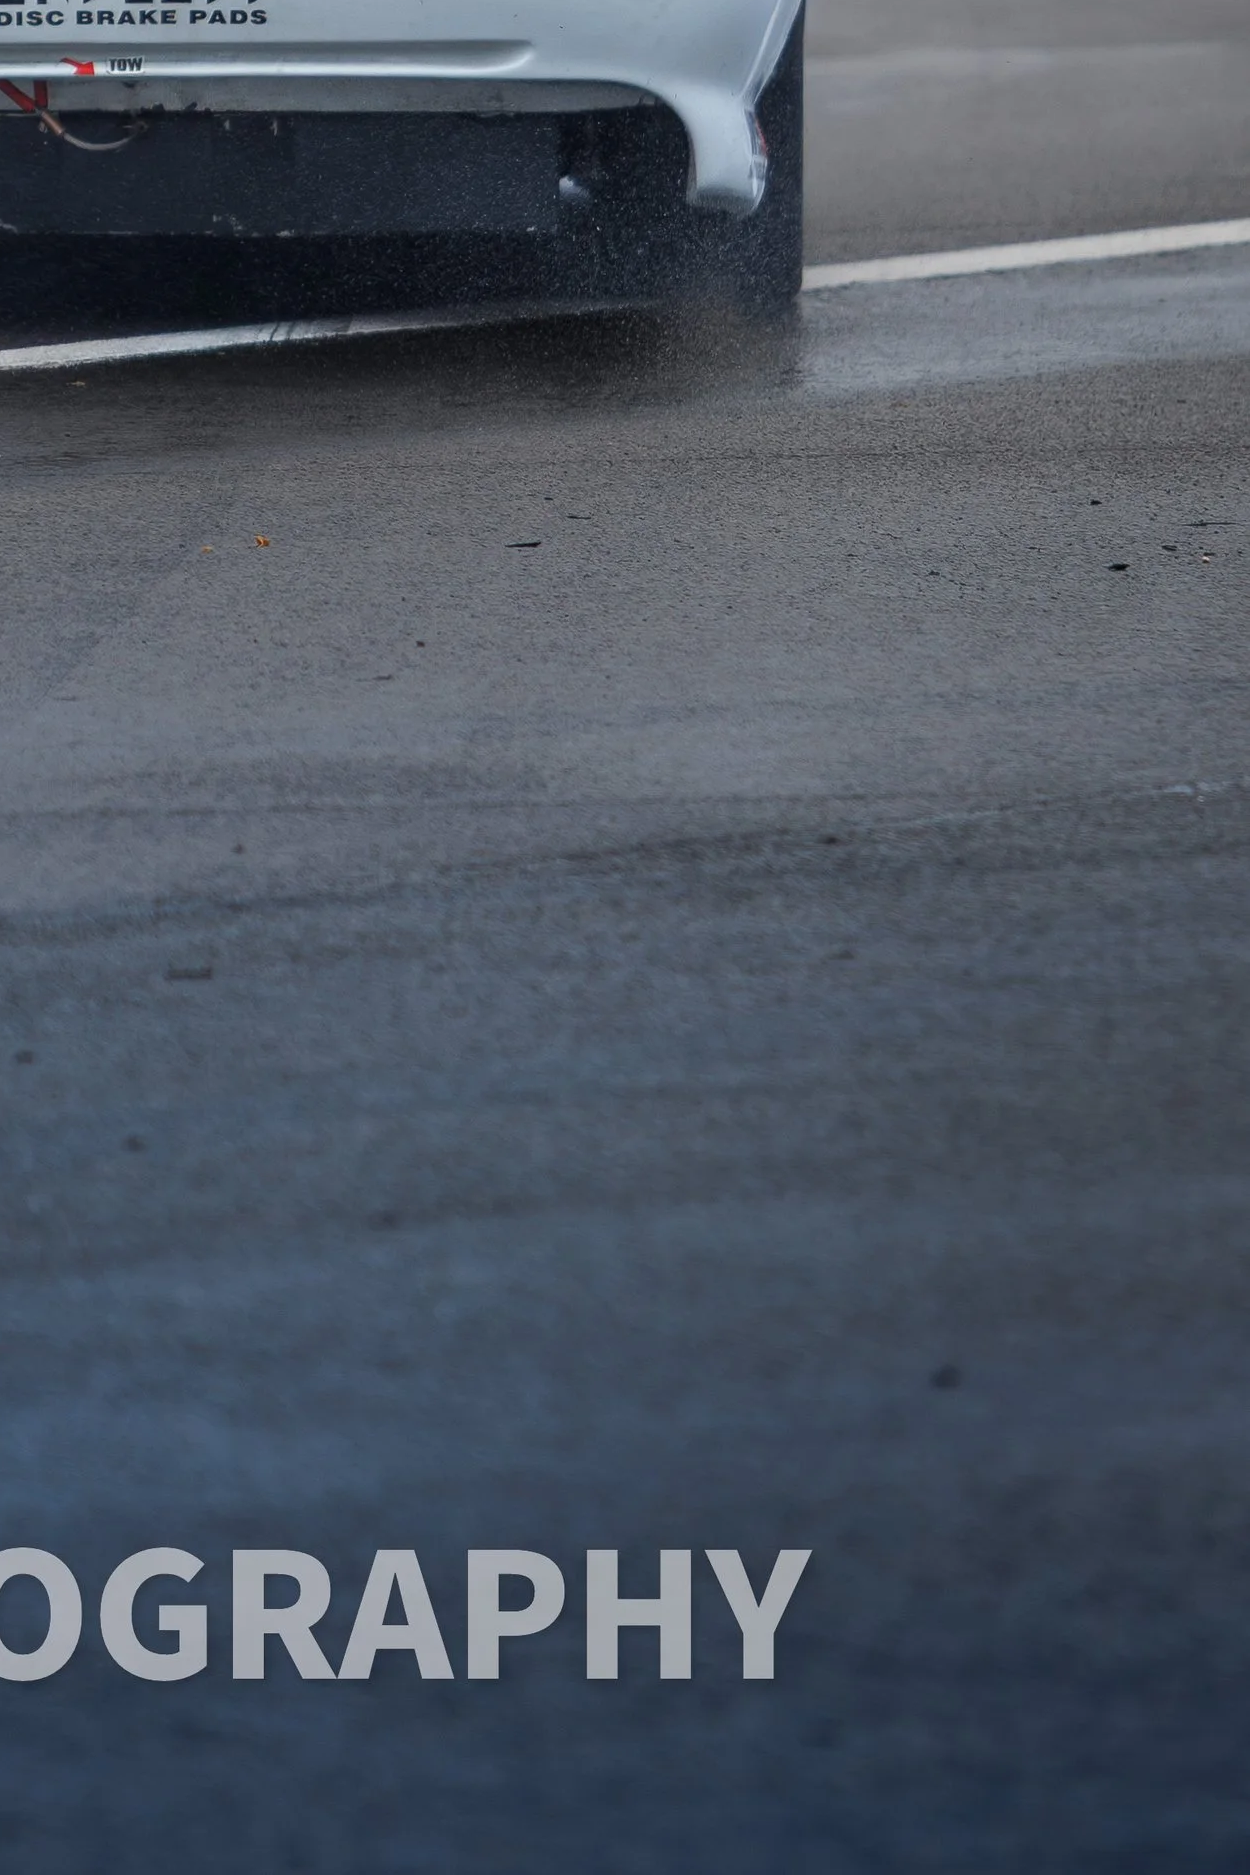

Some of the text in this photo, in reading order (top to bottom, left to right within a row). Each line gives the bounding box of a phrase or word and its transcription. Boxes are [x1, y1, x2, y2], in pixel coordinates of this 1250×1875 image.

[76, 10, 177, 25] BRAKE
[189, 10, 267, 25] PADS
[109, 57, 143, 72] TOW
